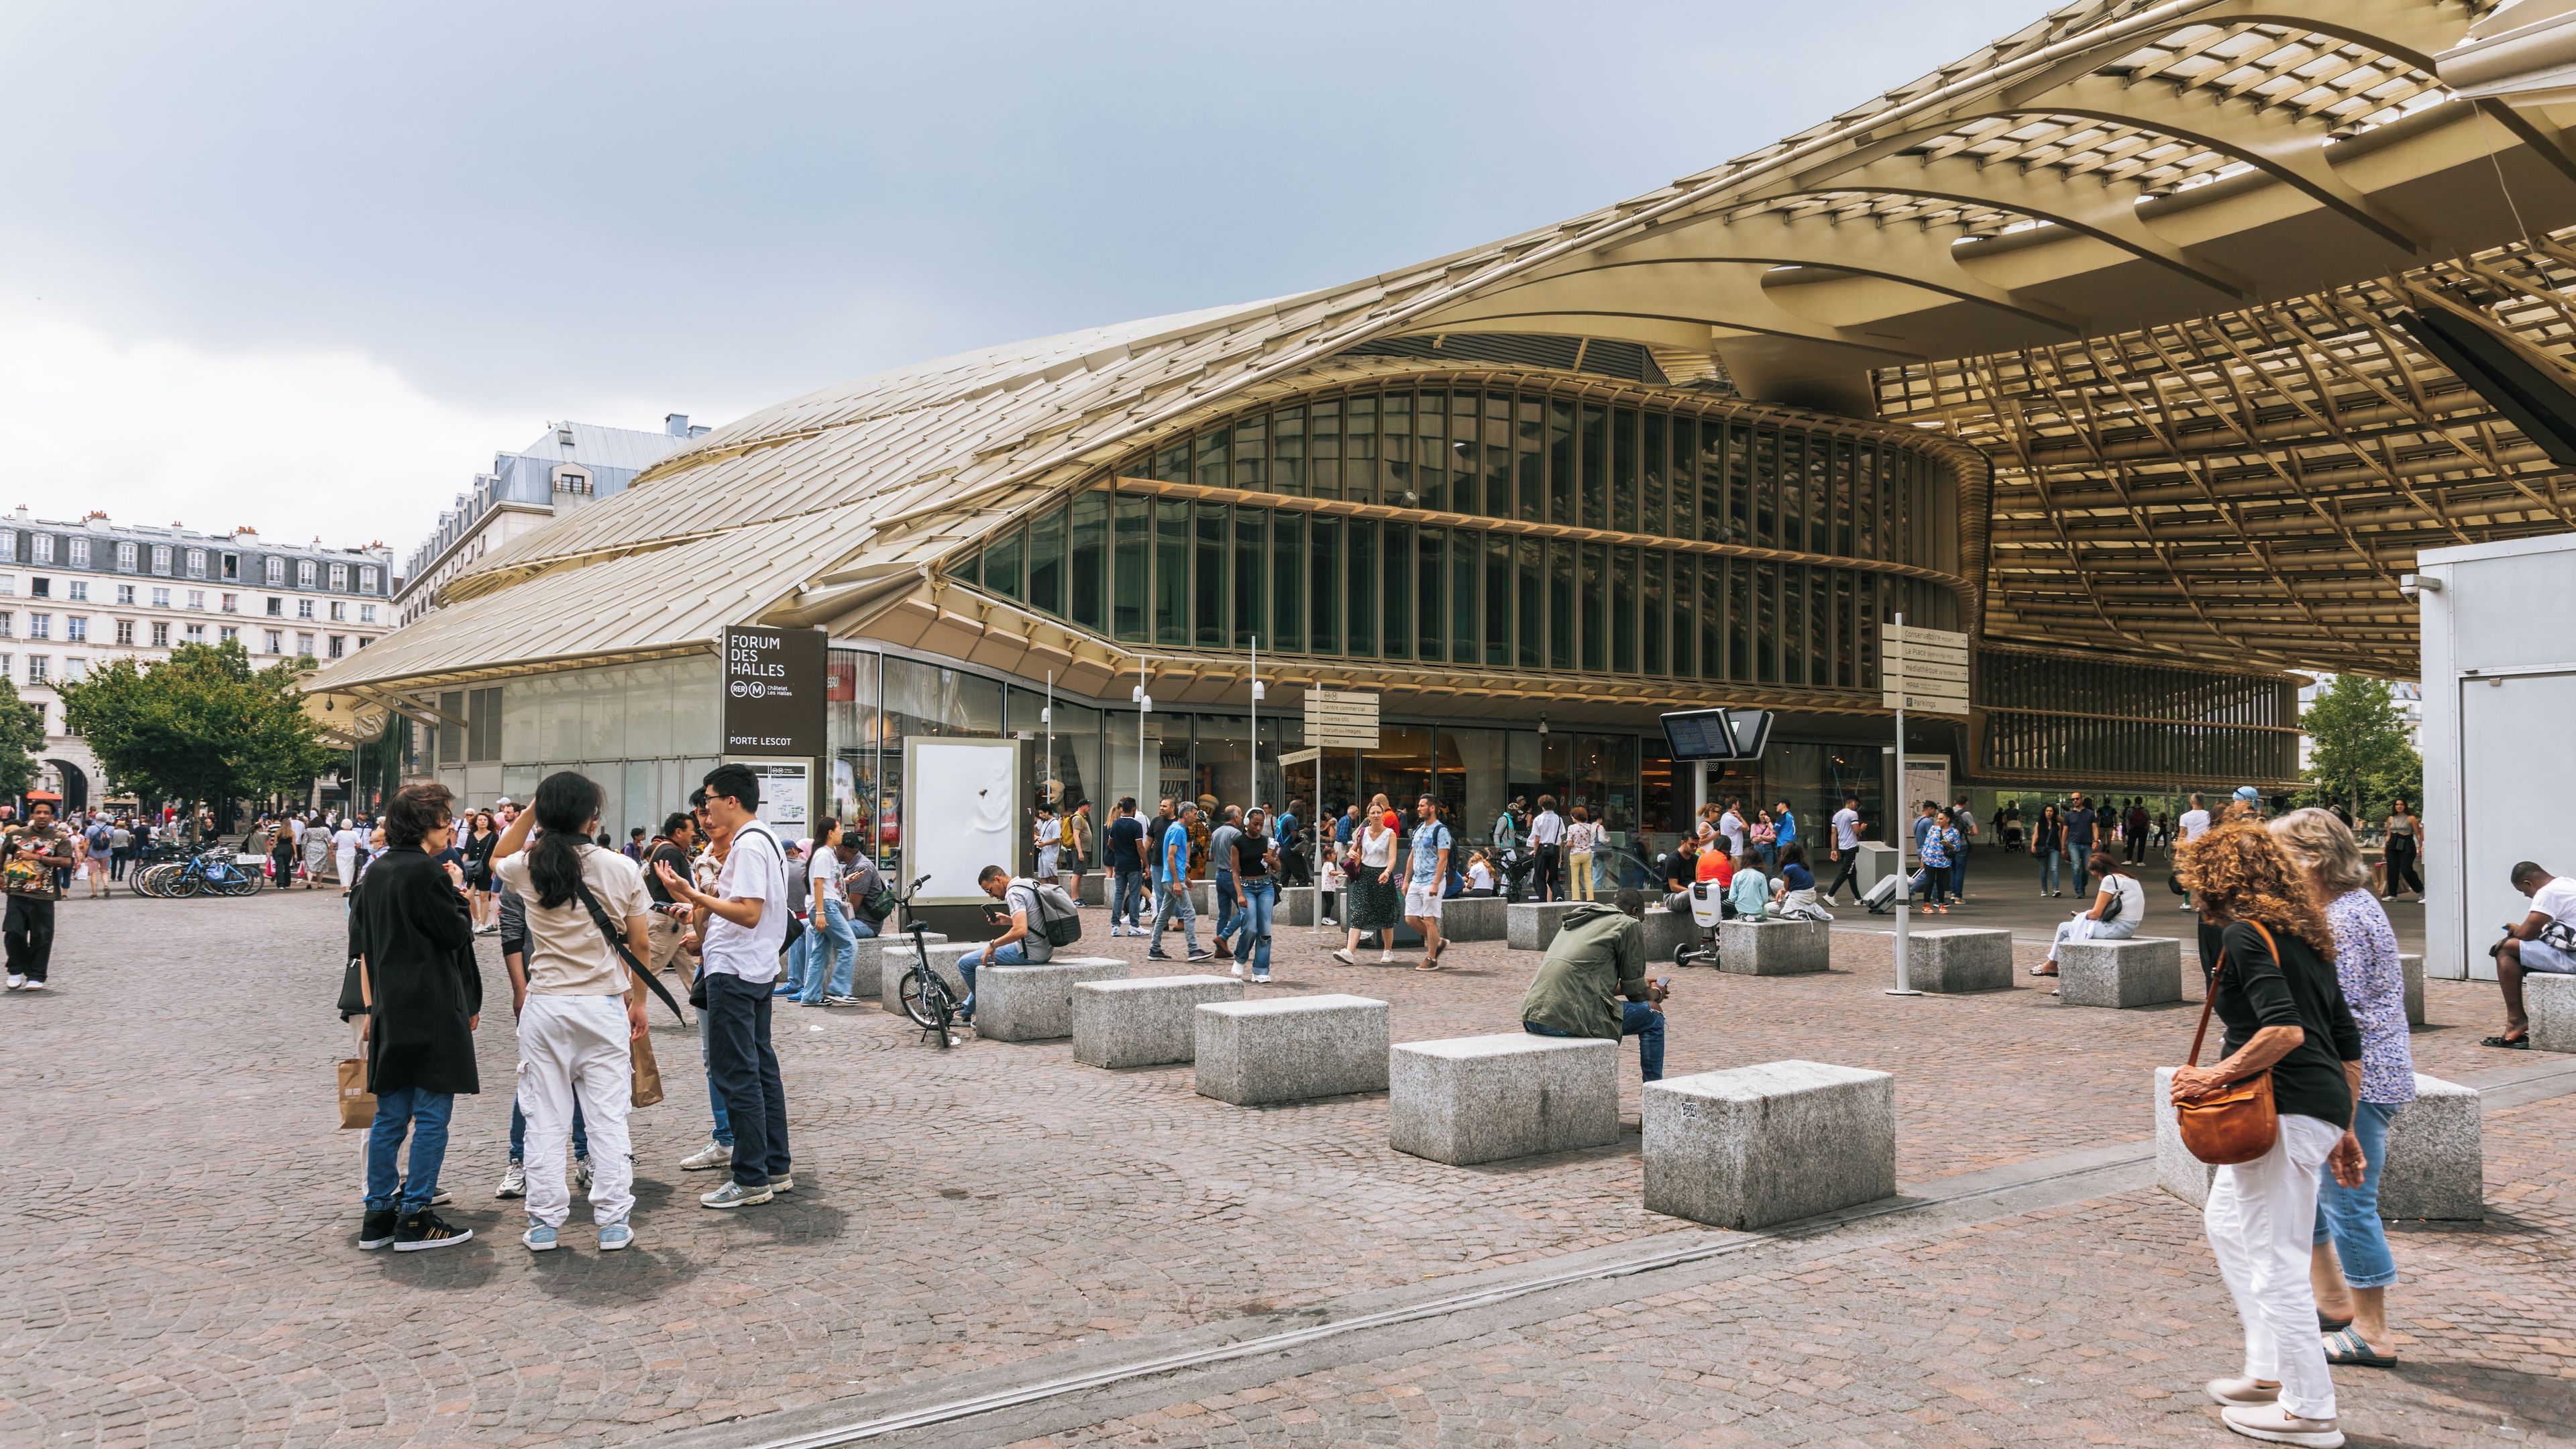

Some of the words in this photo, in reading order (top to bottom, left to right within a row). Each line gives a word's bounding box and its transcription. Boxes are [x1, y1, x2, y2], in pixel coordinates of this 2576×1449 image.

[1905, 631, 1941, 640] Conservatoire
[731, 635, 780, 650] FORUM
[731, 649, 758, 662] DES
[1913, 648, 1926, 656] Place
[731, 662, 785, 677] HALLES
[1906, 664, 1937, 675] Médiathèque
[827, 676, 839, 688] EGO
[752, 685, 762, 694] M
[1914, 700, 1936, 709] Parkings
[730, 737, 758, 745] PORTE
[761, 737, 792, 745] LESCOT
